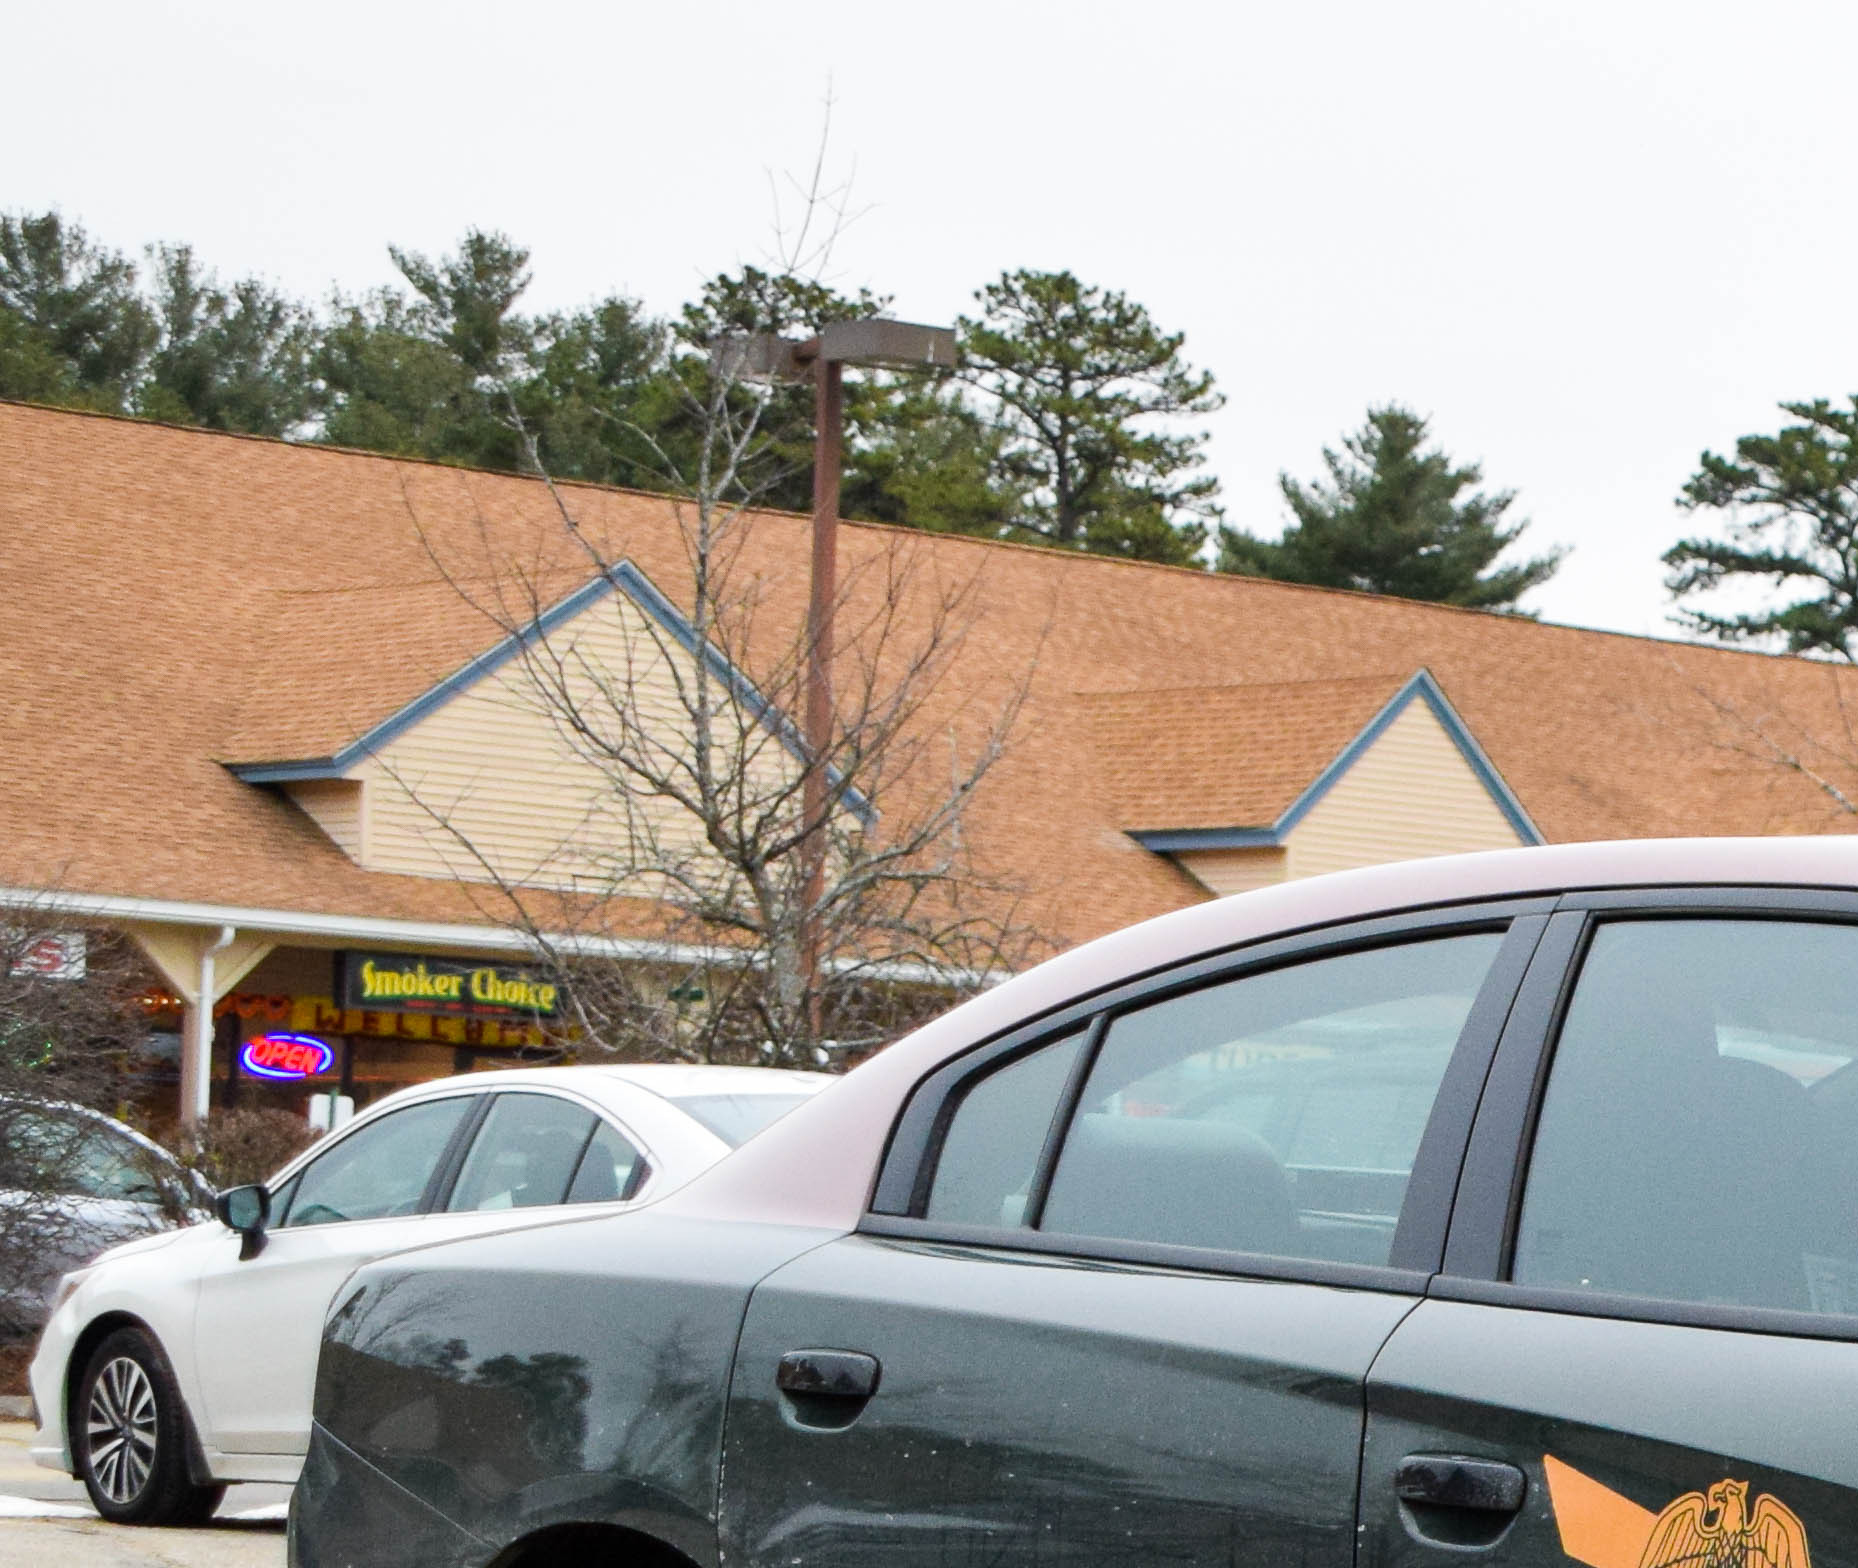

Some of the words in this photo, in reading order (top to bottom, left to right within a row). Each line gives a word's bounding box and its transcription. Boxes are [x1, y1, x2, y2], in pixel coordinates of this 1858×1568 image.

[361, 959, 464, 998] Smoker
[470, 967, 558, 1011] Choice
[252, 1038, 322, 1074] OPEN
